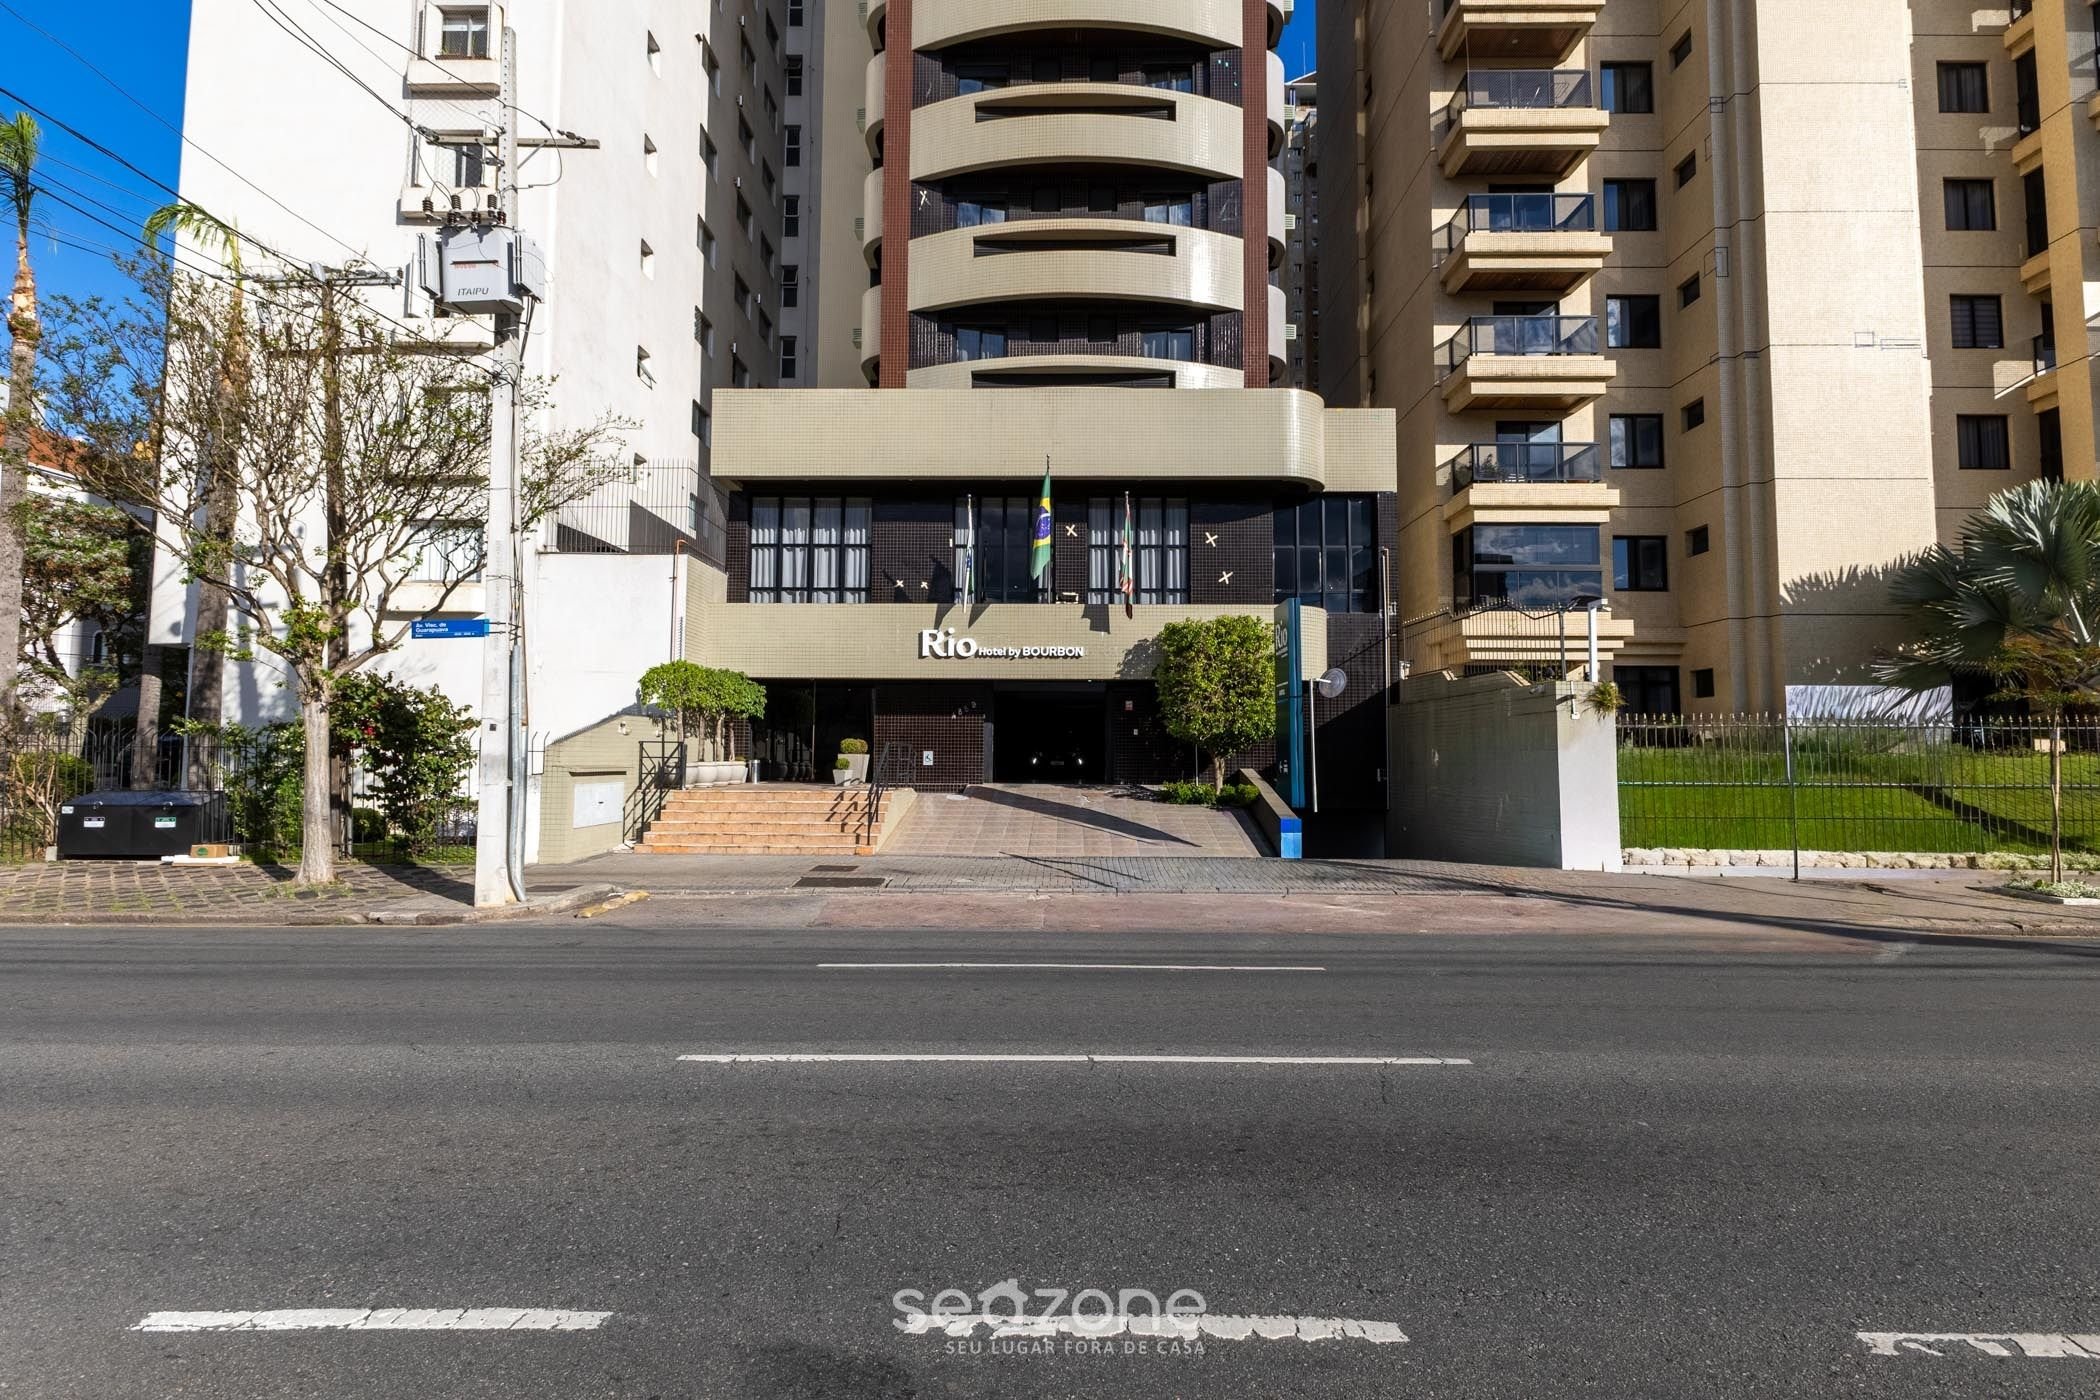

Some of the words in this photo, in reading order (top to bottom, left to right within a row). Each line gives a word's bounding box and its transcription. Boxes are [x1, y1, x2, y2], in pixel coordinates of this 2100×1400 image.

[457, 287, 489, 296] ITAIPU
[921, 627, 978, 657] Rio
[978, 646, 1007, 656] Hotel
[1008, 646, 1022, 658] by
[1022, 646, 1084, 657] BOURBON
[1275, 619, 1288, 651] Rio
